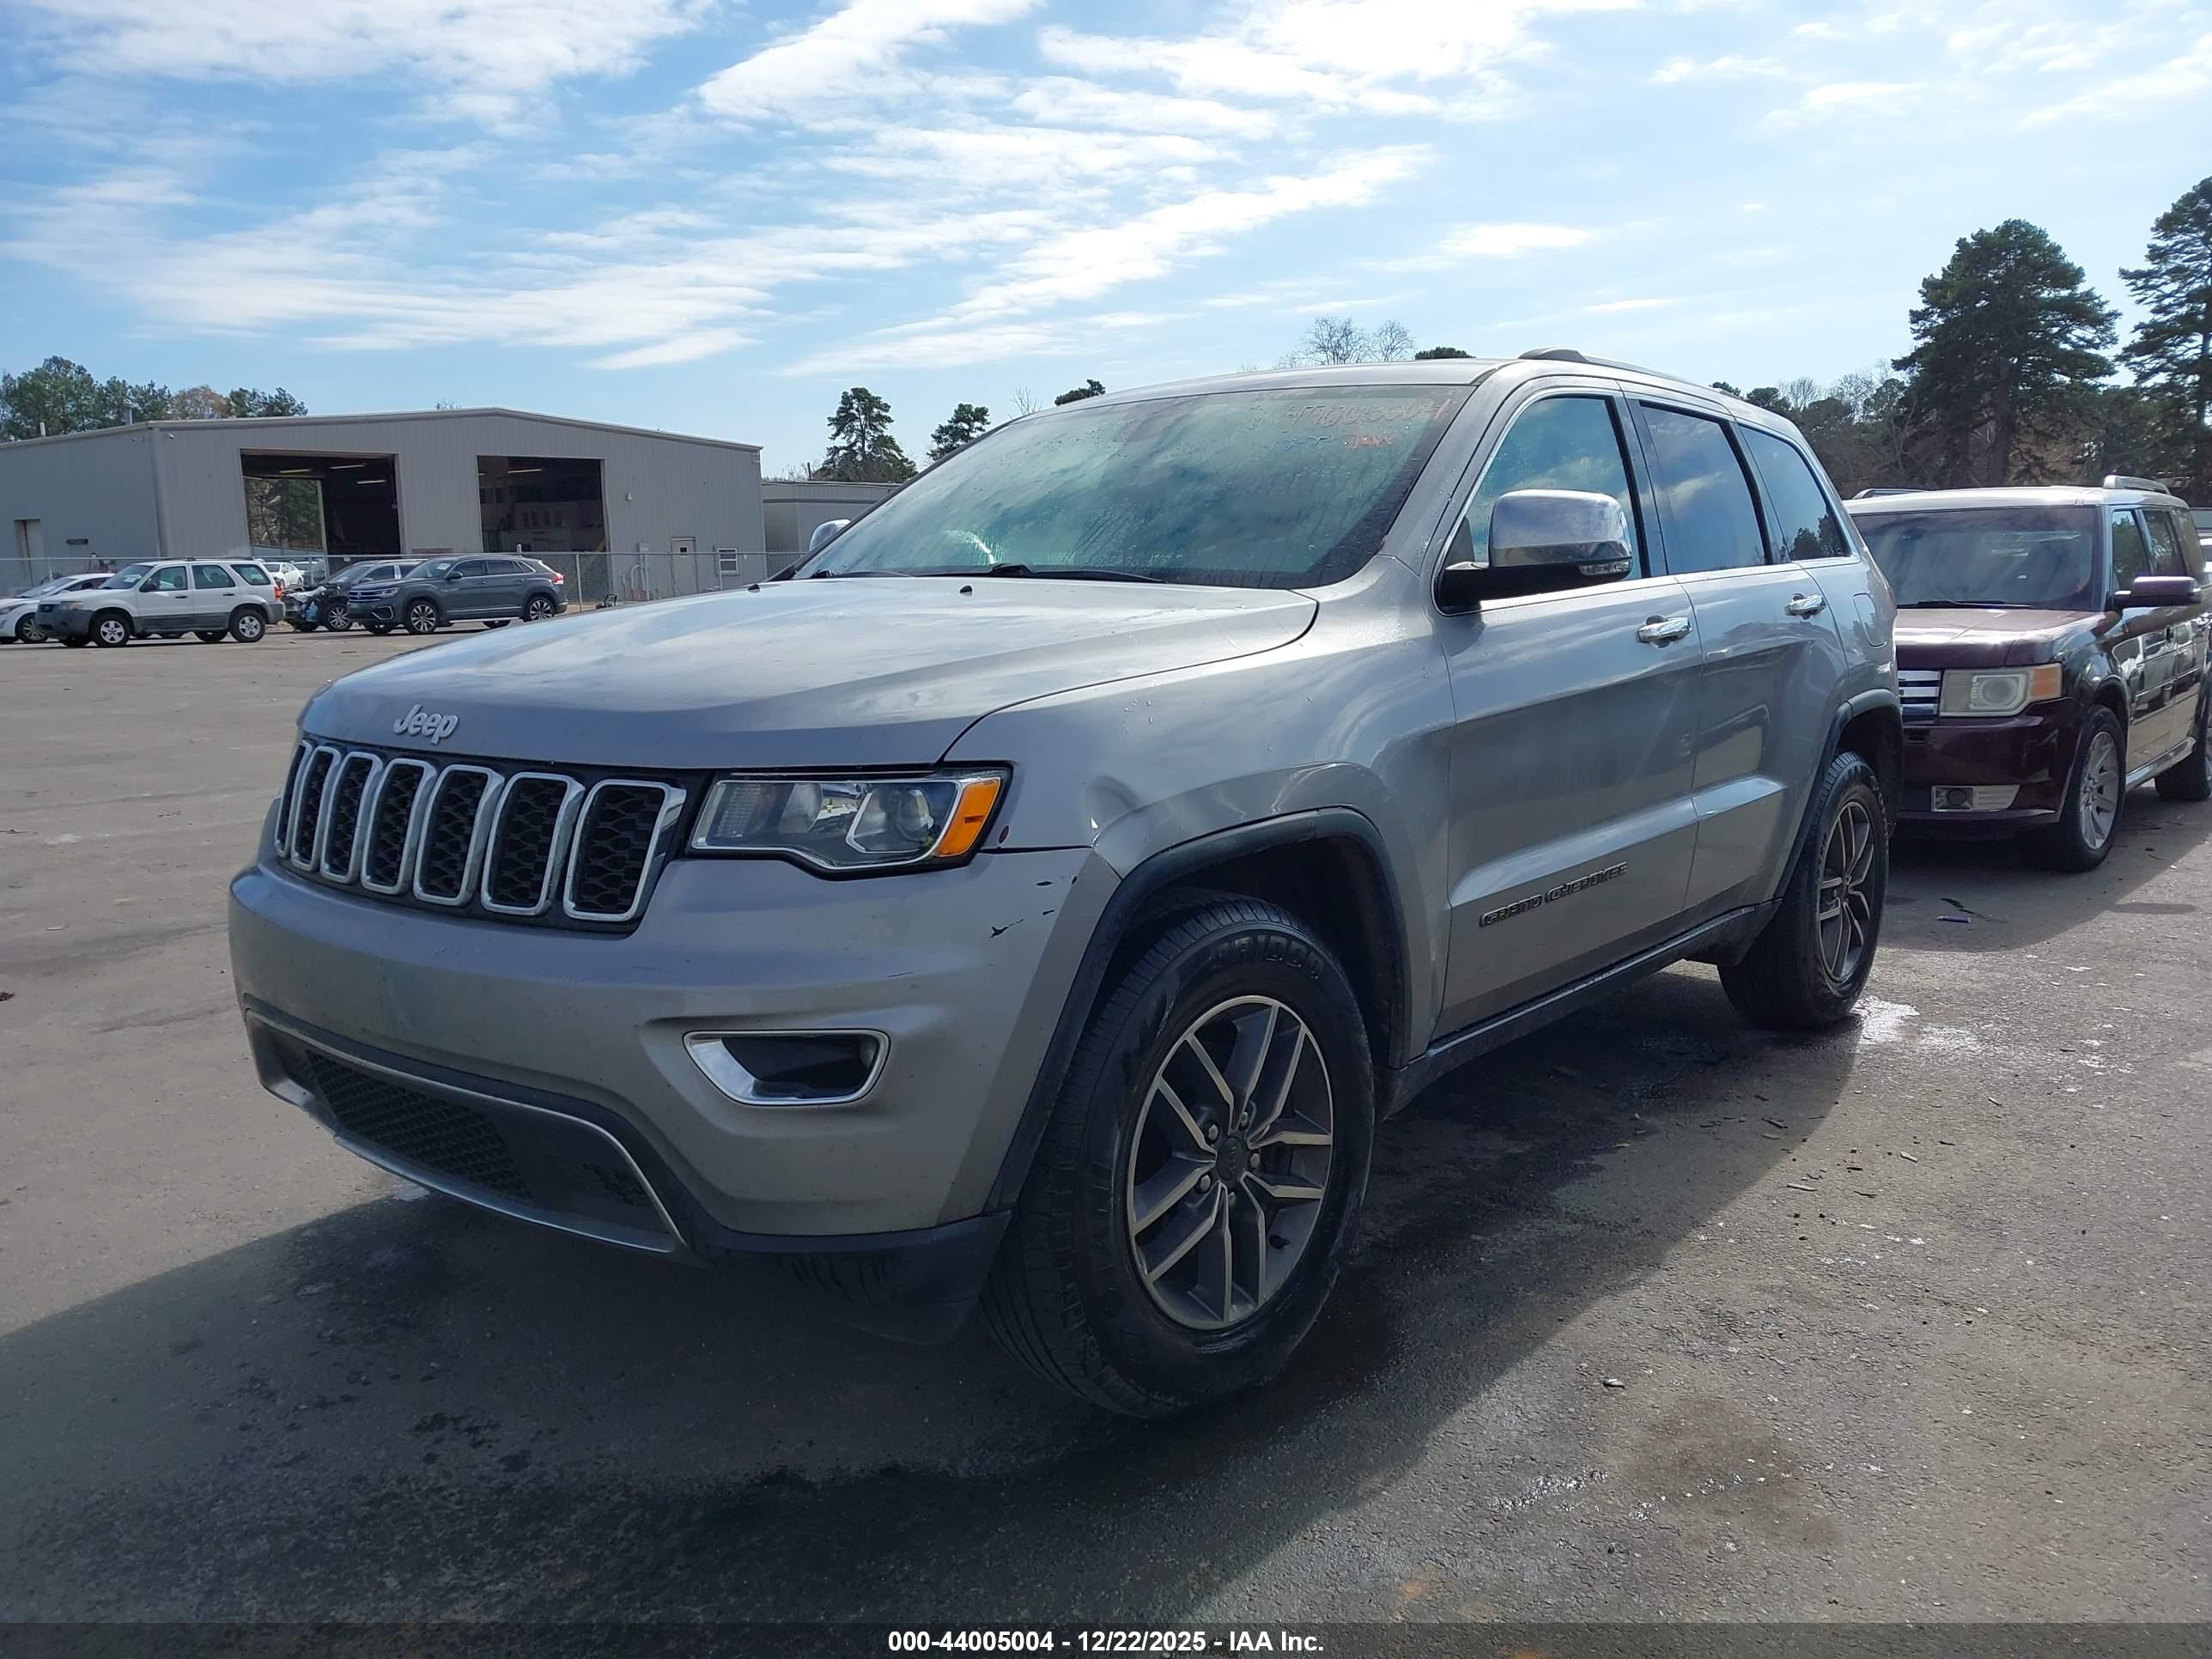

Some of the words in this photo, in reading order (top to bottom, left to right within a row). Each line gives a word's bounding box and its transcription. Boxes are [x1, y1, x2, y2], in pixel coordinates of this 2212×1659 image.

[392, 704, 459, 744] Jeep
[1480, 894, 1542, 927] GRAND
[1544, 861, 1627, 902] CHEROKEE
